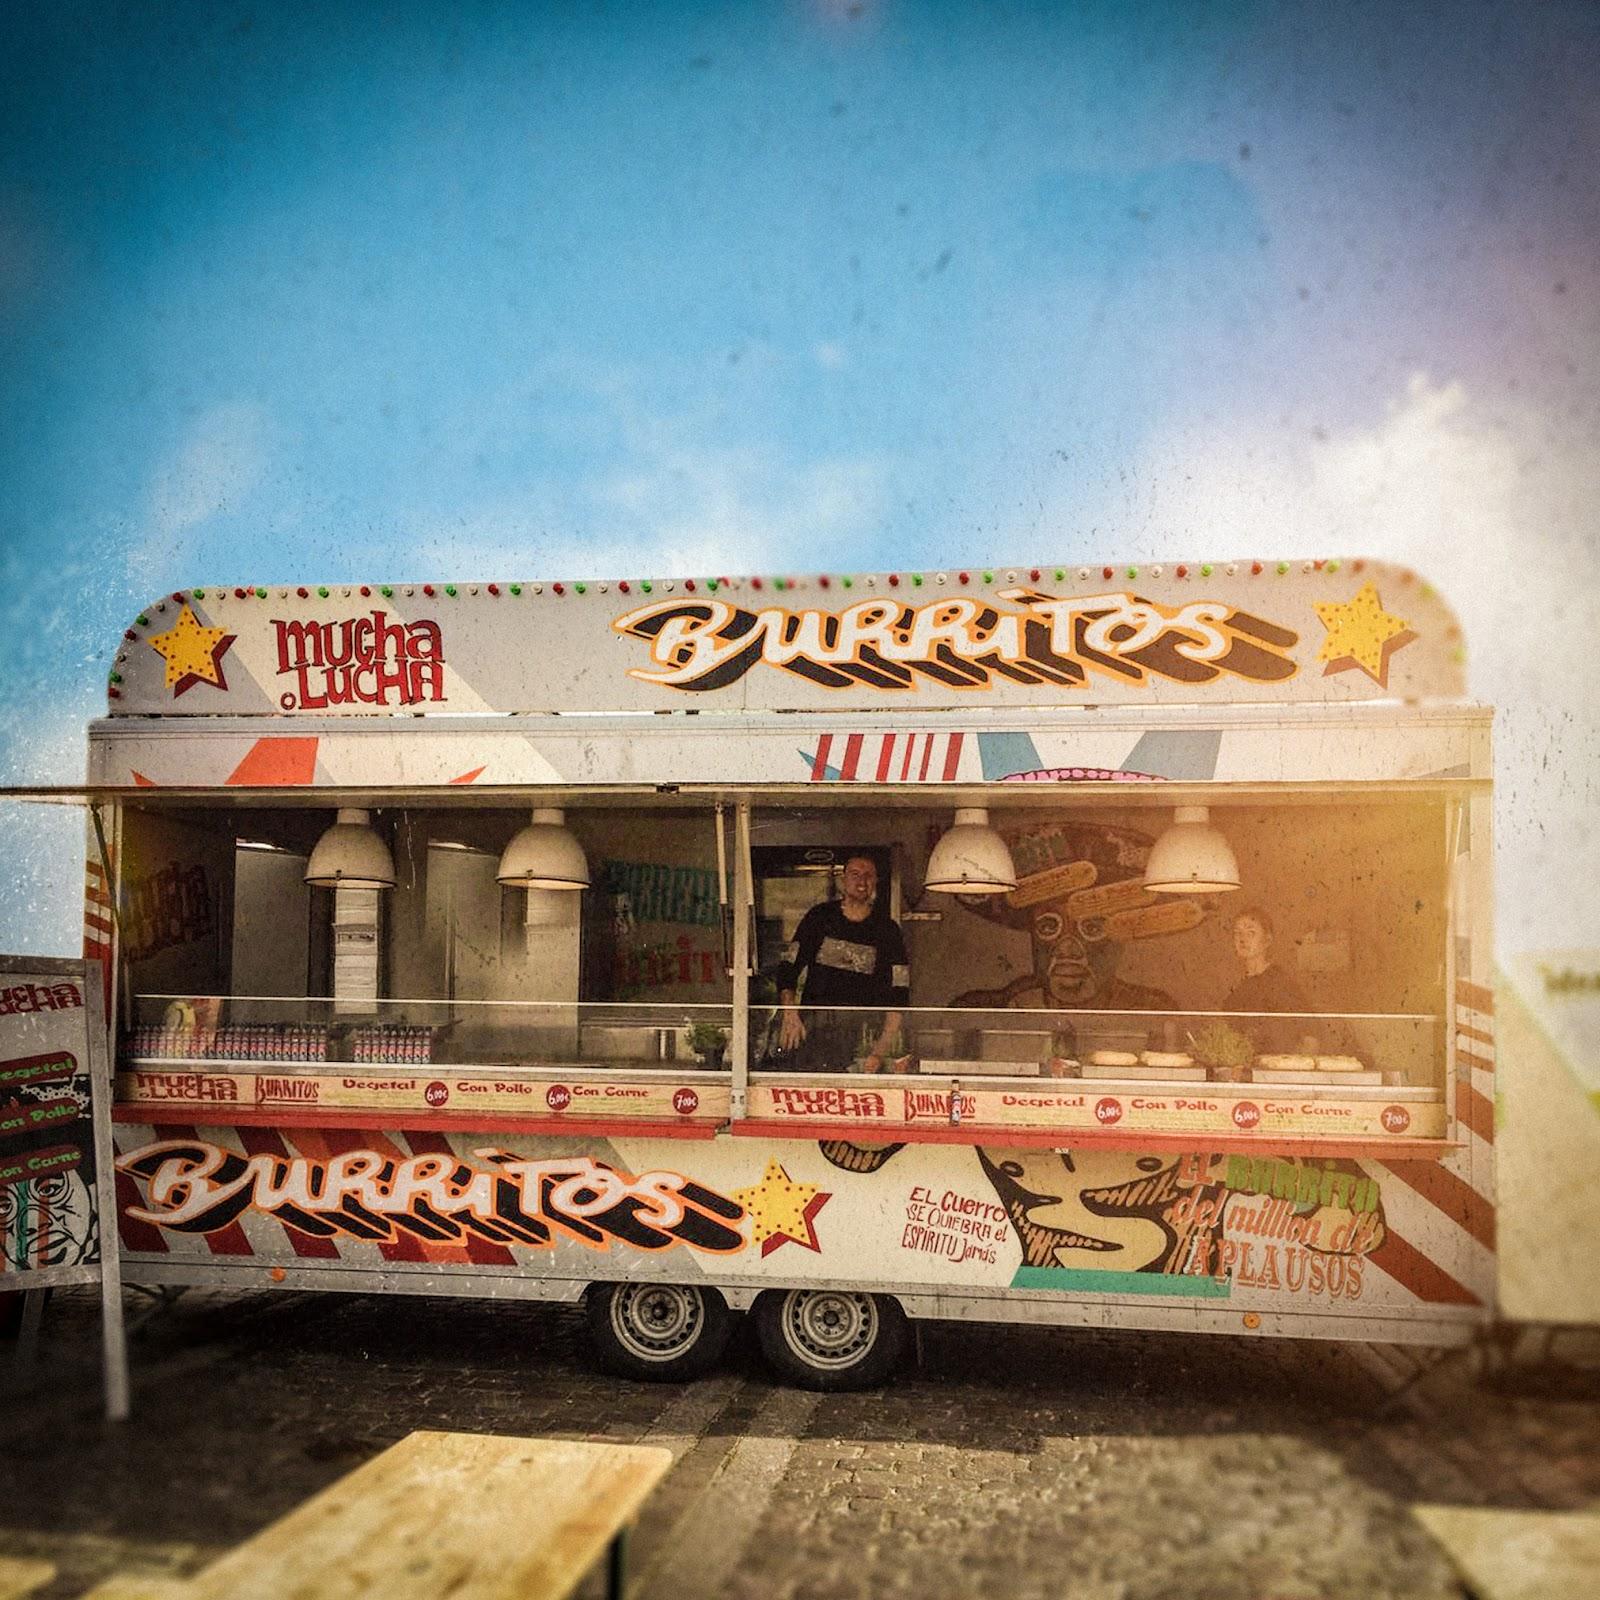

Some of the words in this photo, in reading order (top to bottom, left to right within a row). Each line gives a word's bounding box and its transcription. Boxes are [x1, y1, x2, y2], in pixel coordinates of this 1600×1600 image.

[0, 1058, 73, 1079] egetal
[255, 1075, 320, 1103] BURRITOS
[342, 1079, 416, 1090] Vegetal
[456, 1082, 488, 1093] Con
[494, 1083, 532, 1094] Pollo
[572, 1086, 599, 1096] Con
[604, 1086, 649, 1098] Carne
[1001, 1095, 1085, 1107] Vegetal
[1130, 1099, 1167, 1110] Con
[1174, 1100, 1218, 1112] Pollo
[1264, 1103, 1294, 1114] Con
[1300, 1104, 1353, 1116] Carne
[0, 1118, 24, 1130] on
[30, 1105, 78, 1121] Pollo
[0, 1166, 23, 1181] on
[27, 1151, 81, 1170] Carne
[909, 1186, 938, 1206] EL
[1171, 1185, 1230, 1228] del
[905, 1203, 926, 1222] SE
[927, 1207, 992, 1241] QUIEBRA
[994, 1224, 1008, 1243] el
[1185, 1232, 1364, 1300] APLAUSOS
